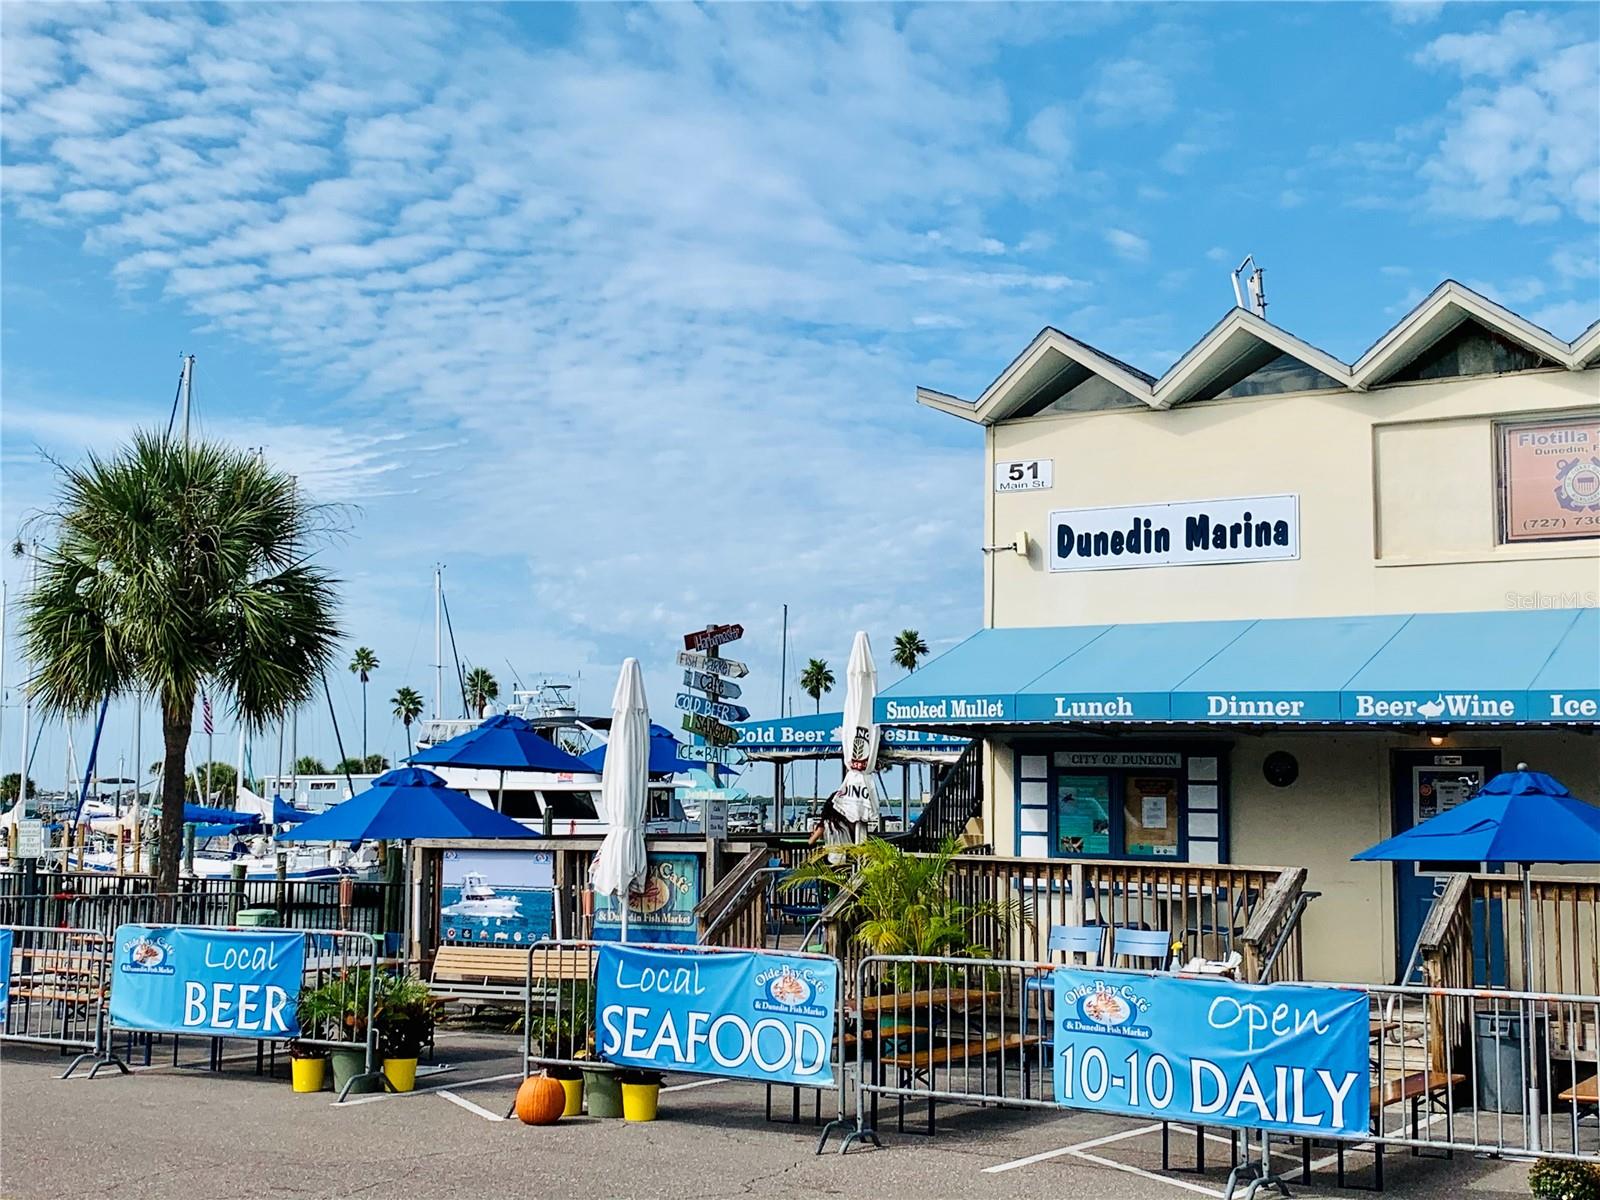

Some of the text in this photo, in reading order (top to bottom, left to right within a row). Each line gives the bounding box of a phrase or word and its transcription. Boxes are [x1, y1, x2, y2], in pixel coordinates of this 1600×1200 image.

[1519, 431, 1588, 446] Flotilla
[1008, 462, 1039, 481] 51
[1000, 480, 1028, 490] Main
[1057, 511, 1289, 559] Dunedin Marina
[1523, 518, 1566, 530] (727)
[680, 652, 698, 668] FISH
[676, 695, 730, 721] COLD BEER
[887, 698, 1004, 720] Smoked Mullet
[1055, 697, 1133, 717] Lunch
[1208, 696, 1304, 716] Dinner
[1356, 694, 1515, 716] Beer Wine
[1550, 694, 1597, 716] Ice
[696, 715, 733, 742] SANGRIA
[736, 727, 775, 743] Cold
[781, 727, 826, 743] Beer
[678, 745, 694, 759] ICE
[704, 747, 730, 763] BAIT
[1072, 754, 1177, 766] CITY OF DUNEDIN
[659, 862, 692, 895] Café
[598, 911, 606, 921] &
[644, 912, 660, 922] Fish
[661, 913, 691, 924] Market
[205, 940, 279, 971] Local
[616, 959, 706, 996] Local
[755, 964, 828, 994] Olde Bay Café
[183, 980, 290, 1033] BEER
[1064, 980, 1152, 1014] Olde Bay Café
[755, 1001, 825, 1016] & Dunedin Fish Market
[1066, 1021, 1150, 1039] & Dunedin Fish Market
[1207, 995, 1329, 1053] Open
[601, 1004, 827, 1076] SEAFOOD
[1060, 1042, 1360, 1129] 10-10 DAILY
